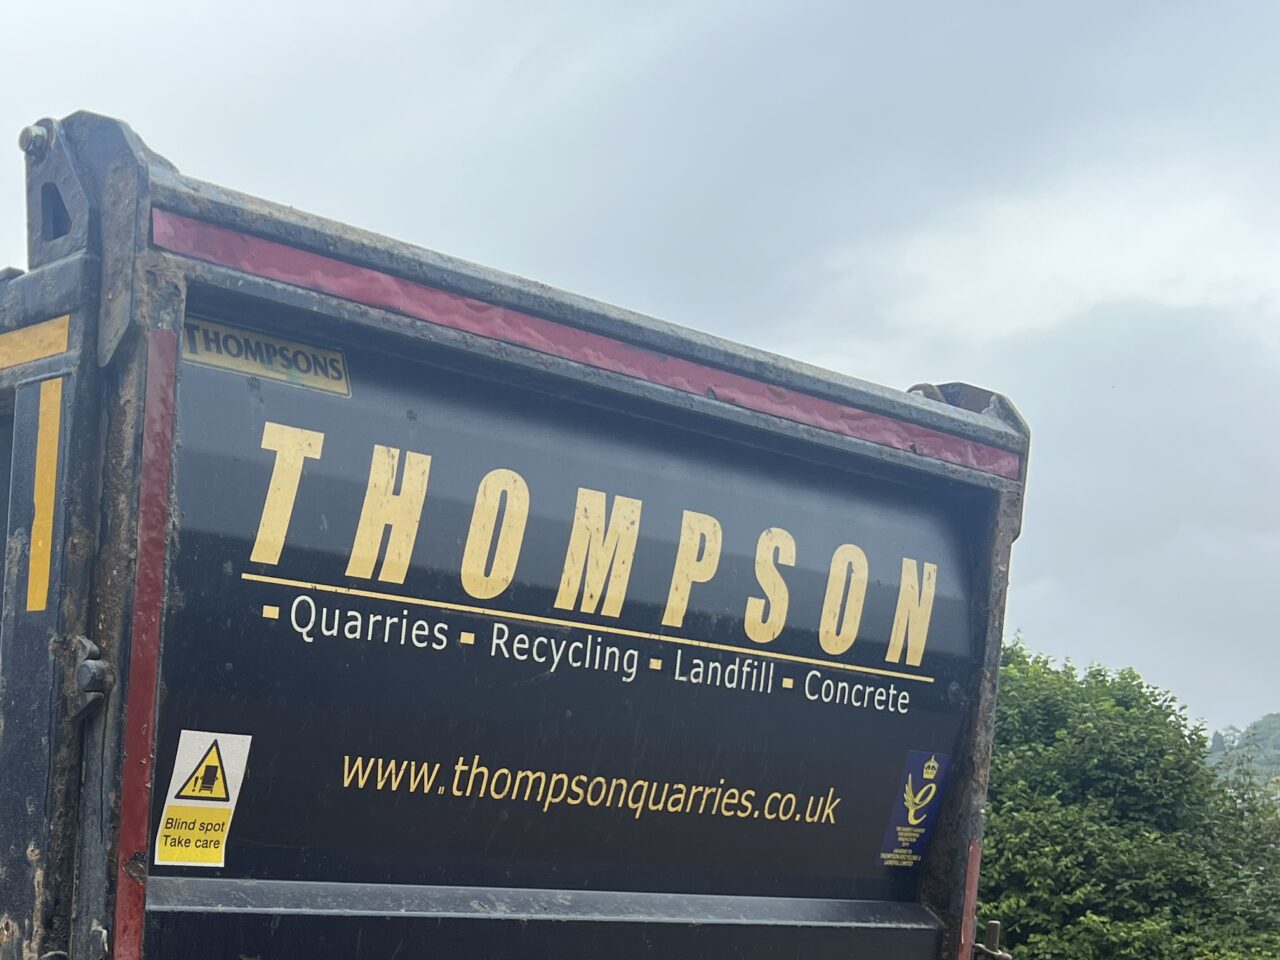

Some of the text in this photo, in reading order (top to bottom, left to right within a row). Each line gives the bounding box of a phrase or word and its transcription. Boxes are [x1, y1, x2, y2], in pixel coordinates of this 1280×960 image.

[184, 323, 343, 381] THOMPSONS
[250, 422, 938, 667] THOMPSON
[290, 595, 910, 714] Quarries Recycling Landfill Concrete
[342, 754, 841, 825] www.thompsonquarries.co.uk
[163, 835, 220, 849] Take care
[165, 818, 225, 834] Blind spot
